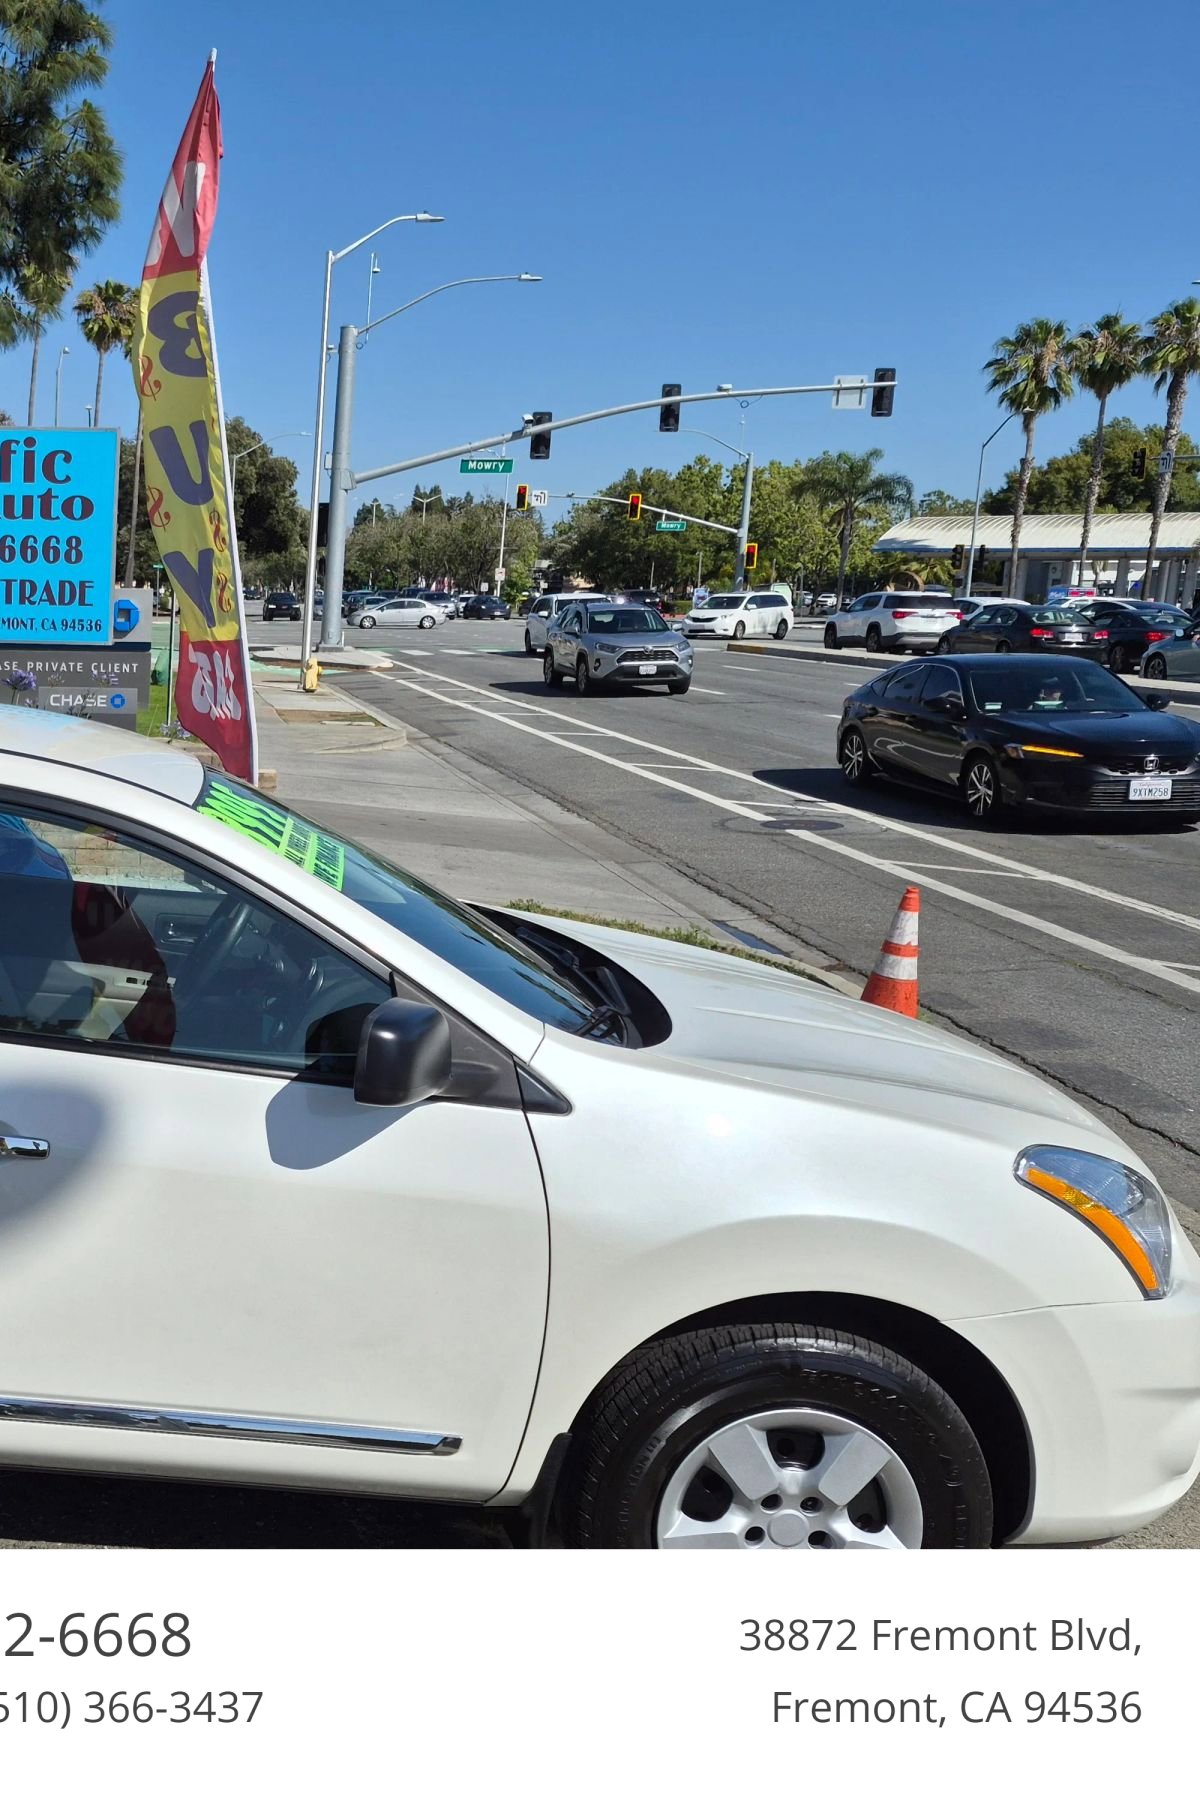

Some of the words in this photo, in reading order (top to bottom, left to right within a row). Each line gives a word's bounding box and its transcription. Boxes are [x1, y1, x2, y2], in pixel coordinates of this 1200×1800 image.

[467, 460, 505, 473] Mowry
[0, 578, 94, 607] TRADE
[40, 618, 58, 632] CA
[61, 618, 103, 633] 94536
[26, 661, 84, 673] PRIVATE
[91, 662, 140, 674] CLIENT
[49, 694, 108, 707] CHASE
